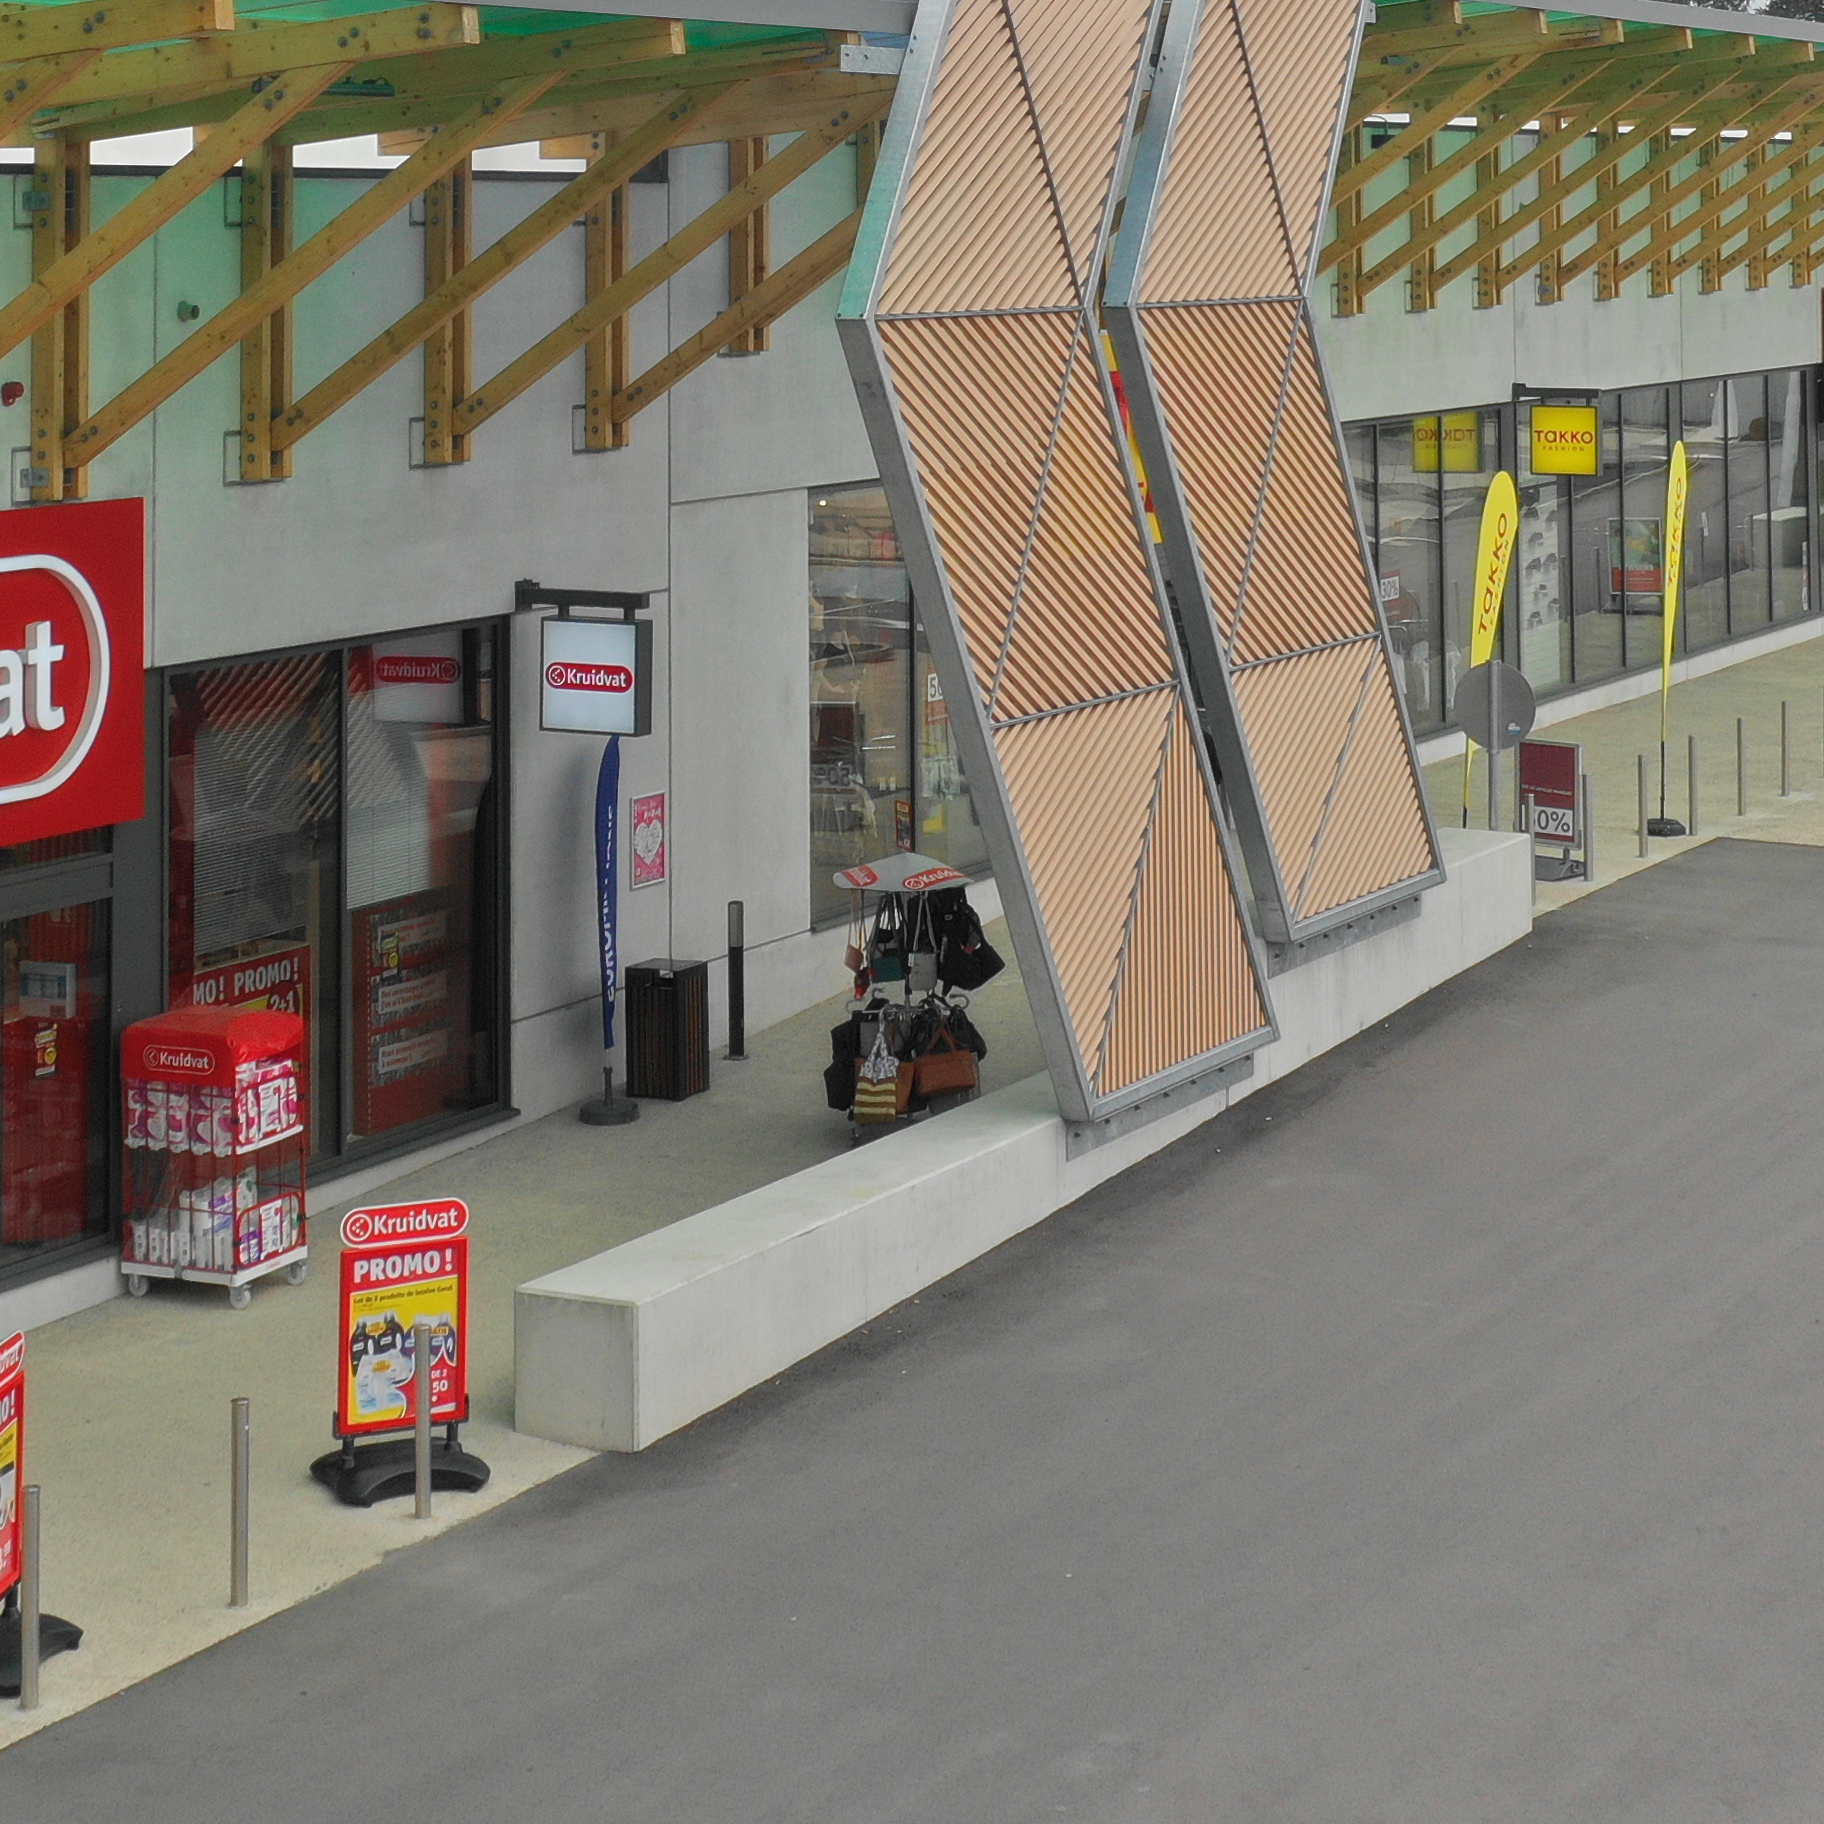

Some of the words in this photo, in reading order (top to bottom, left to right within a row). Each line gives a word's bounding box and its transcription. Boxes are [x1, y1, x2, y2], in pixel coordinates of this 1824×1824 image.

[567, 668, 627, 688] Kruidvat
[159, 1051, 209, 1070] Kruidvat
[374, 1207, 458, 1236] Kruidvat
